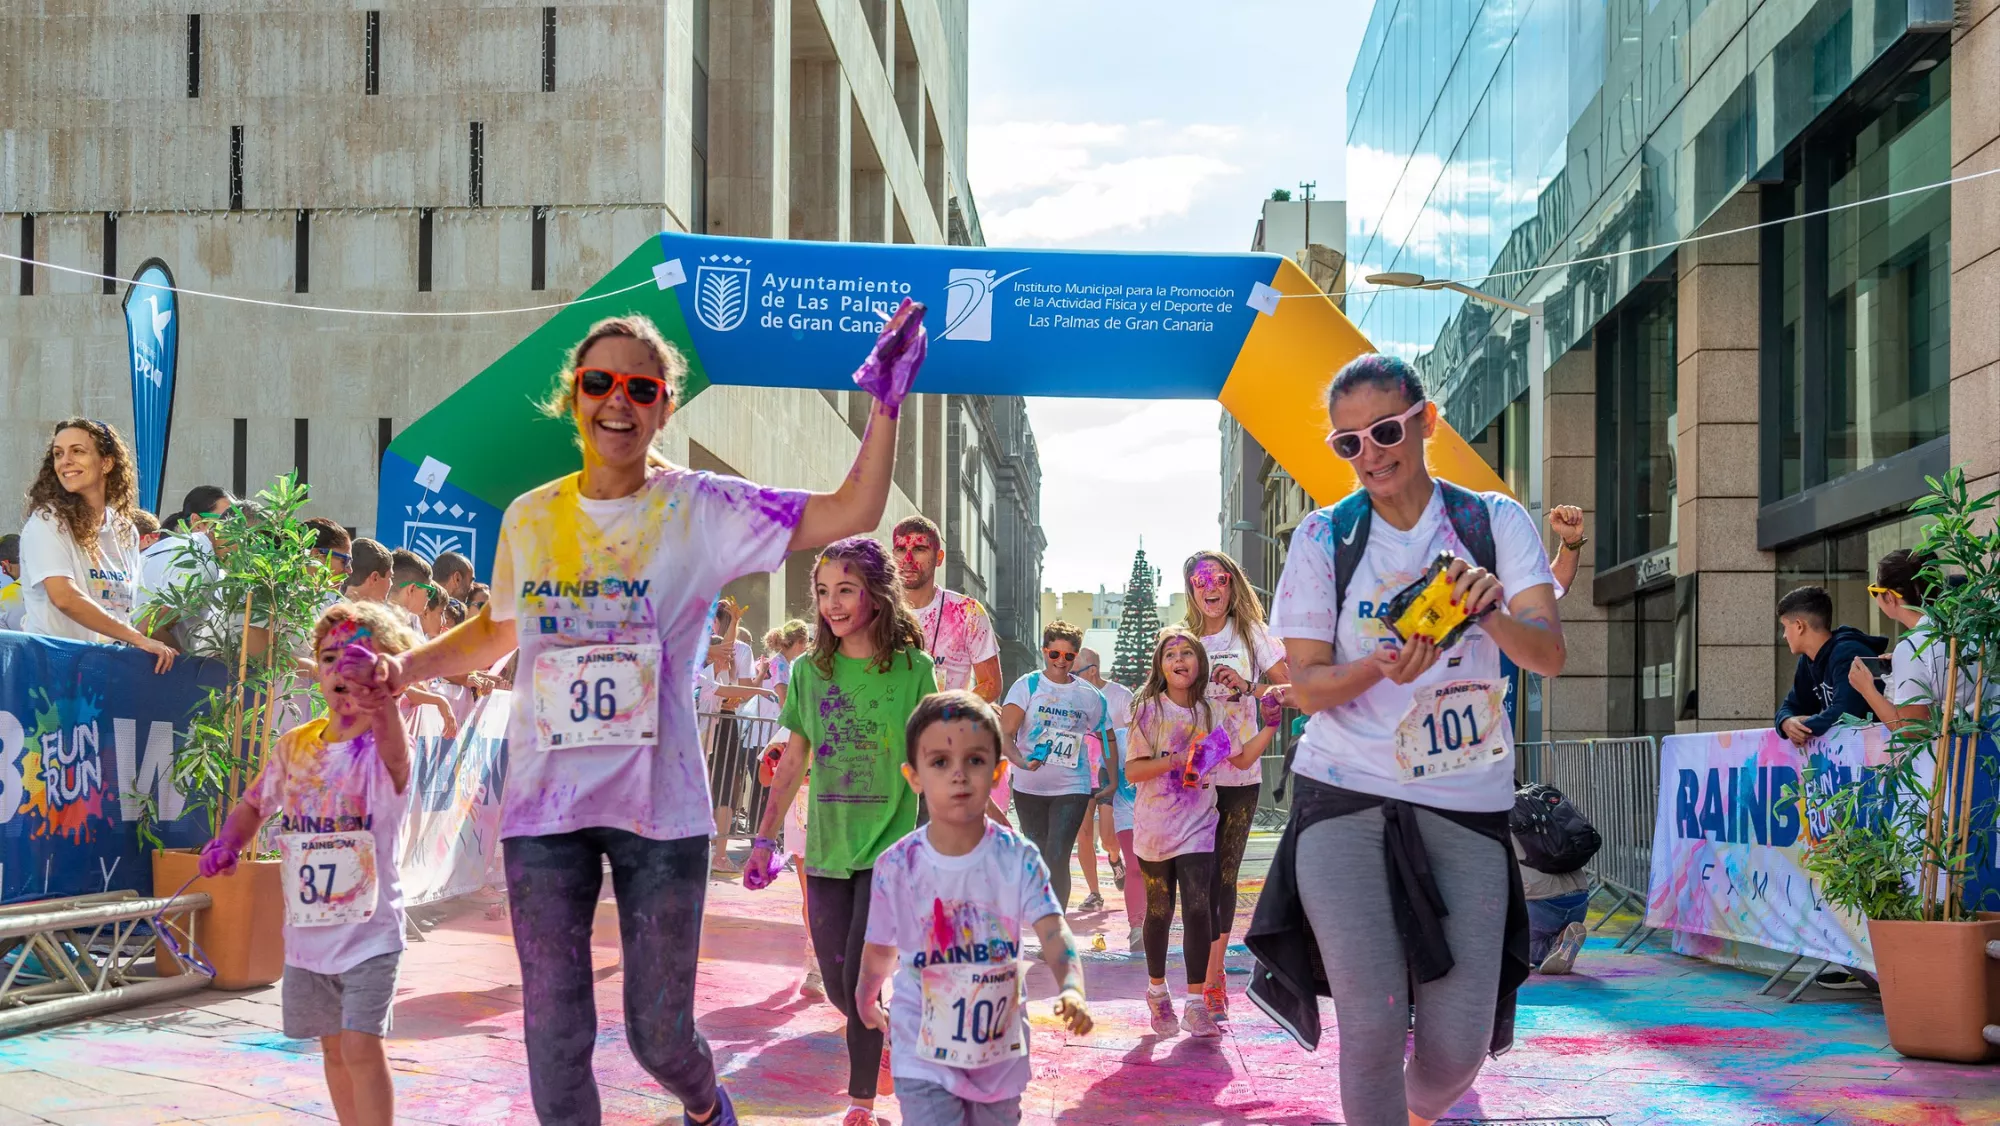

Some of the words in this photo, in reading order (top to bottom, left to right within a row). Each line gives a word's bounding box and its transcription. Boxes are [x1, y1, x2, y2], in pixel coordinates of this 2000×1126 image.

[762, 272, 912, 292] Ayuntamiento
[1014, 281, 1062, 294] Instituto
[1065, 283, 1123, 298] Municipal
[1125, 286, 1153, 299] para
[1156, 285, 1167, 297] la
[1170, 286, 1235, 299] Promoción
[761, 291, 785, 308] de
[797, 293, 828, 311] Las
[841, 296, 900, 314] Palma
[1014, 296, 1031, 308] de
[1033, 296, 1044, 308] la
[1046, 297, 1102, 310] Actividad
[1105, 297, 1137, 311] Física
[1140, 301, 1148, 313] y
[1151, 300, 1161, 312] el
[1164, 300, 1213, 315] Deporte
[1216, 301, 1233, 313] de
[760, 311, 783, 329] de
[788, 313, 832, 331] Gran
[839, 316, 885, 334] Cana
[1029, 314, 1050, 328] Las
[1054, 315, 1100, 329] Palmas
[1104, 316, 1121, 330] de
[1125, 317, 1158, 331] Gran
[1162, 318, 1214, 332] Canaria
[570, 677, 617, 723] 36
[41, 718, 101, 768] FUN
[1422, 704, 1482, 756] 101
[43, 755, 102, 807] RUN
[299, 863, 336, 904] 37
[951, 996, 1008, 1044] 102
